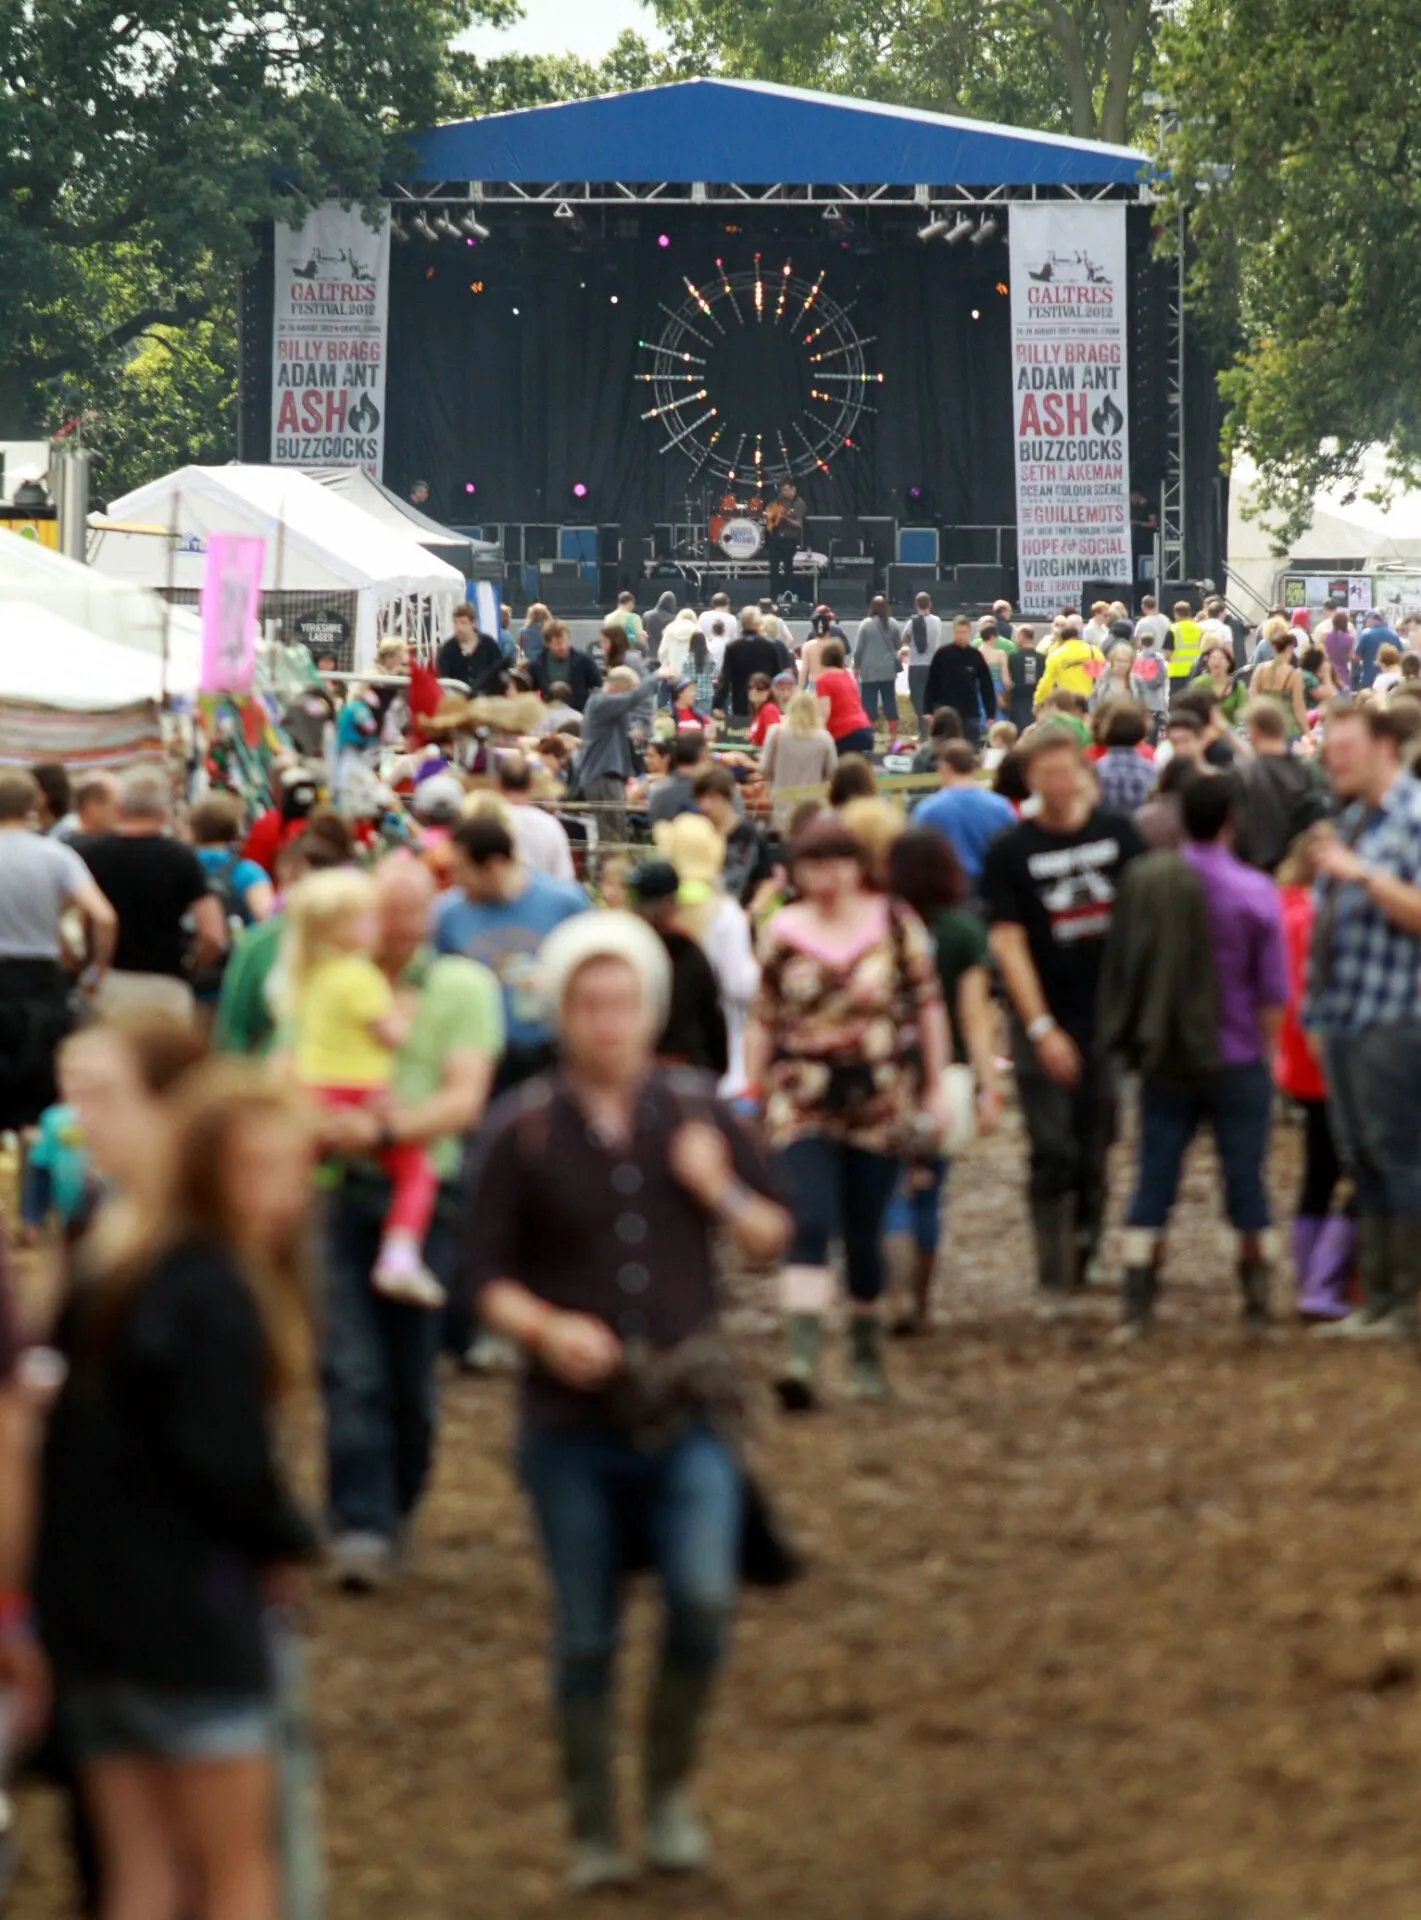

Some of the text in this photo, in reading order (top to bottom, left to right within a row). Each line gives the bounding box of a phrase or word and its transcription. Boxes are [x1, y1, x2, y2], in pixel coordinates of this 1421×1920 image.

[290, 283, 376, 301] GALTRES
[1027, 285, 1113, 304] GALTRES
[291, 303, 375, 315] FESTIVAL 2012
[1028, 306, 1113, 319] FESTIVAL 2012
[278, 340, 381, 361] BILLY BRAGG
[1016, 342, 1121, 364] BILLY BRAGG
[278, 363, 380, 387] ADAM ANT
[1018, 365, 1121, 390] ADAM ANT
[277, 389, 348, 433] ASH
[1019, 392, 1088, 436] ASH
[276, 437, 378, 459] BUZZCOCKS
[1020, 440, 1122, 461] BUZZCOCKS
[1020, 463, 1123, 481] SETH LAKEMAN
[1021, 483, 1123, 497] OCEAN COLOUR SCENE
[1034, 505, 1124, 523] GUILLEMOTS
[1022, 539, 1060, 555] HOPE
[1078, 538, 1126, 555] SOCIAL
[1024, 596, 1054, 608] ELLEN
[300, 623, 342, 633] YORKSHIRE
[308, 632, 334, 642] LAGER
